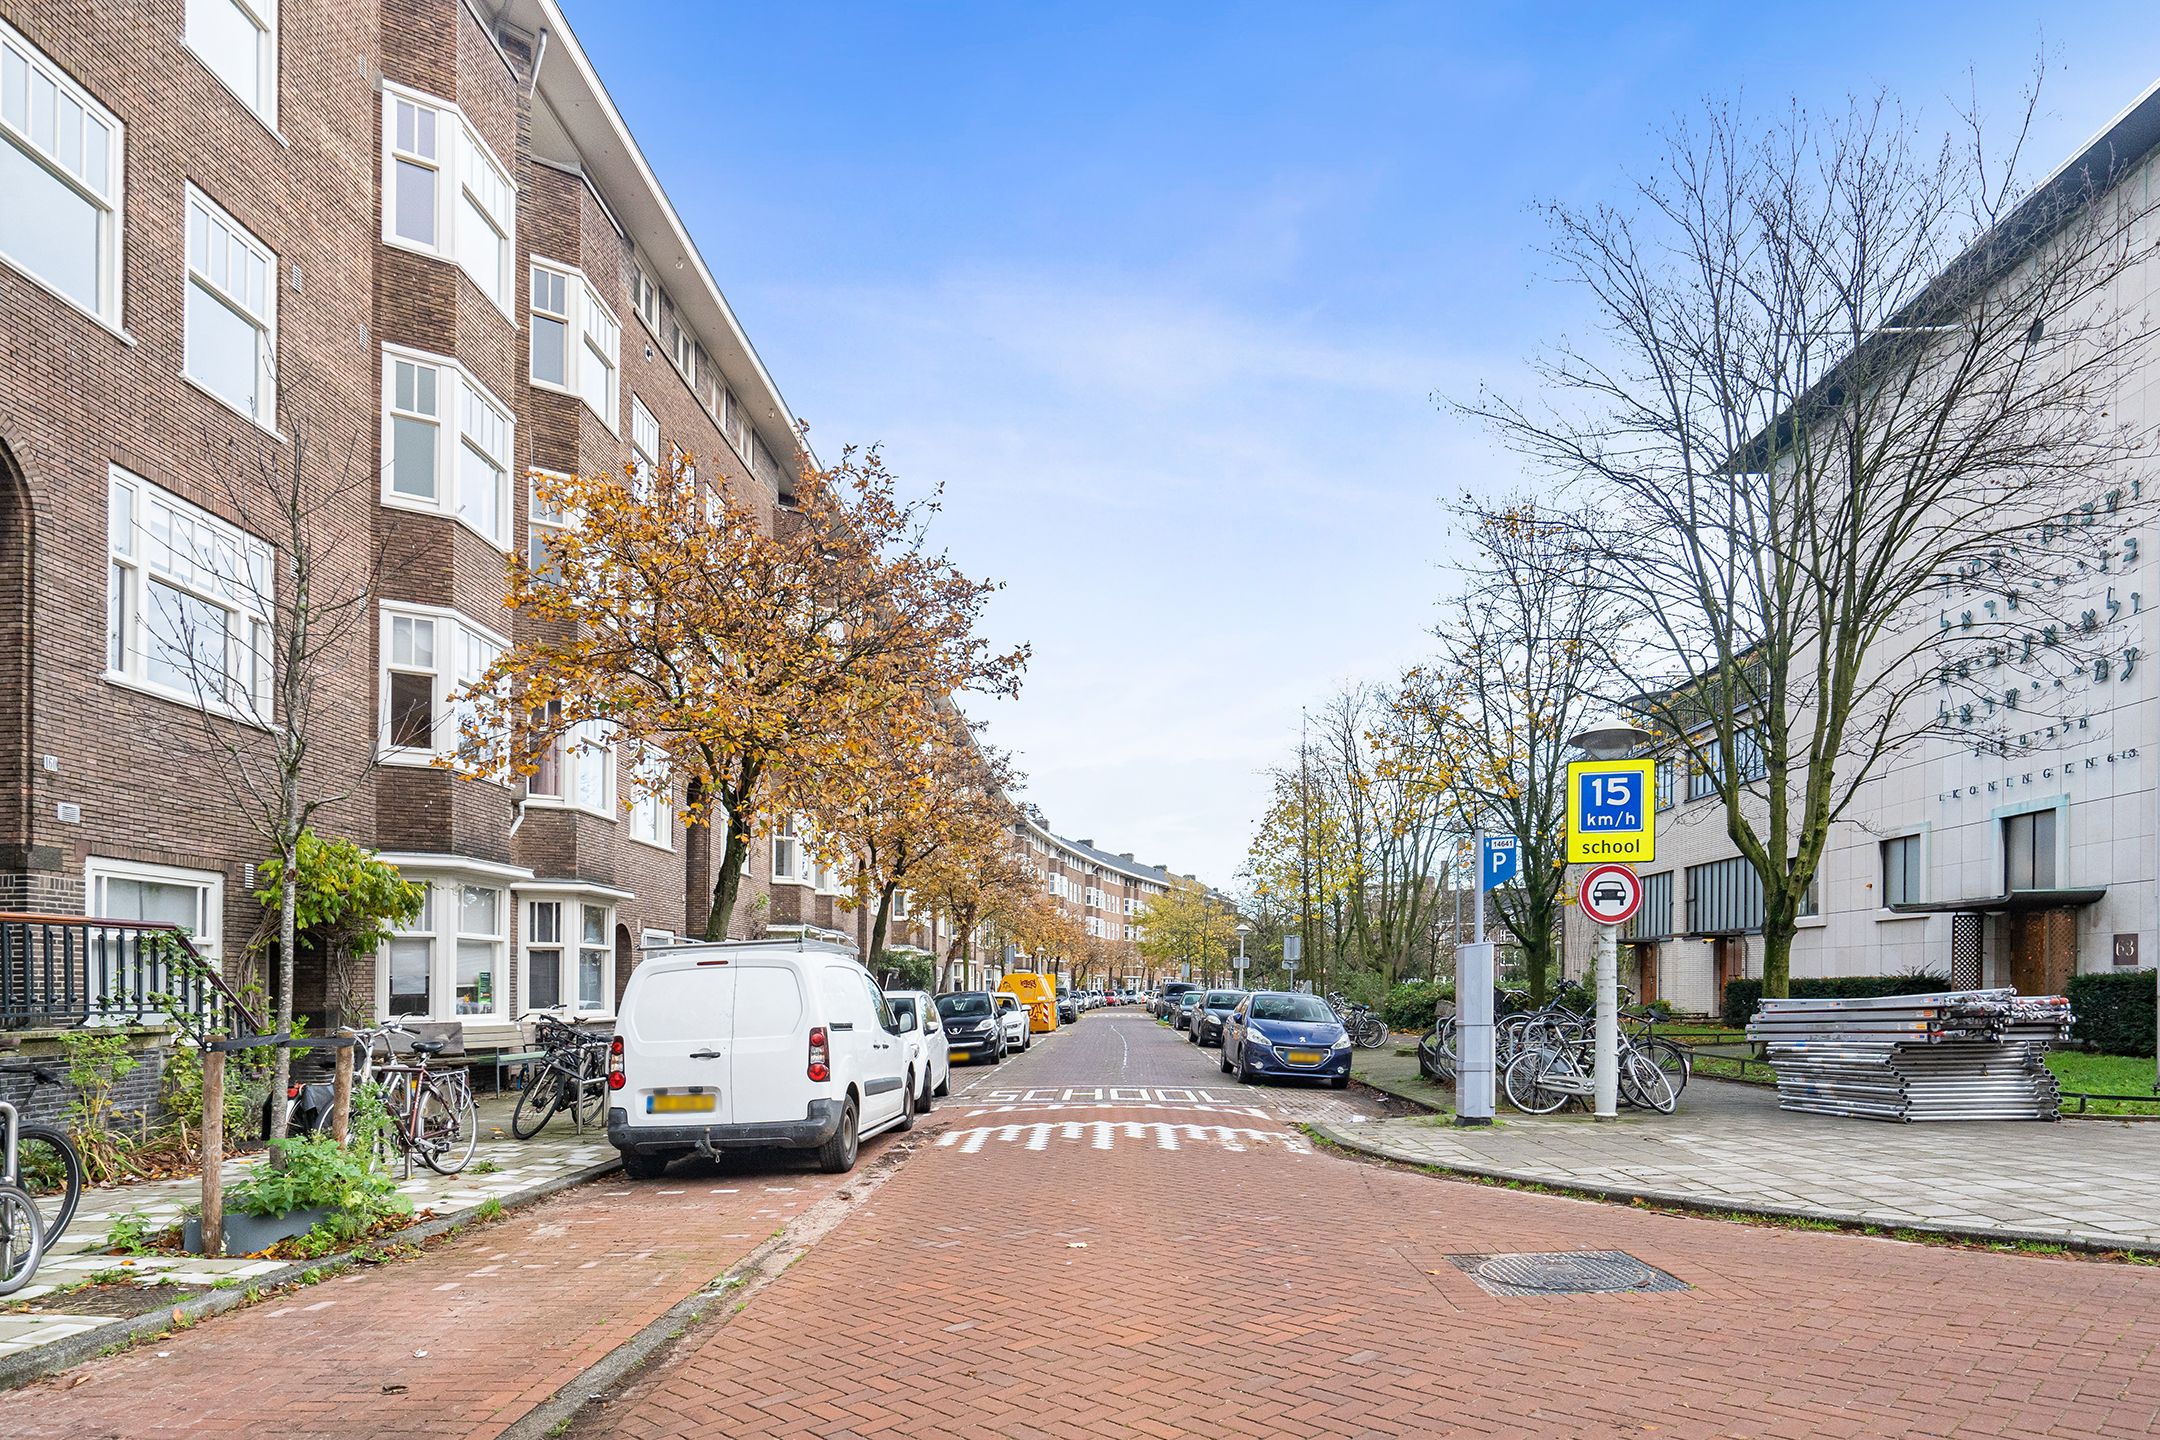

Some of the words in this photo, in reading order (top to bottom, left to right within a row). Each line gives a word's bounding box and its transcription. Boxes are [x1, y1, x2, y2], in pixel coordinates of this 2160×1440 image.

[1591, 777, 1631, 806] 15
[1586, 811, 1635, 828] km/h
[1493, 840, 1513, 848] 14641
[1581, 838, 1640, 855] school
[1492, 851, 1507, 873] P
[2115, 940, 2135, 957] 63
[981, 1088, 1231, 1103] SCHOOL
